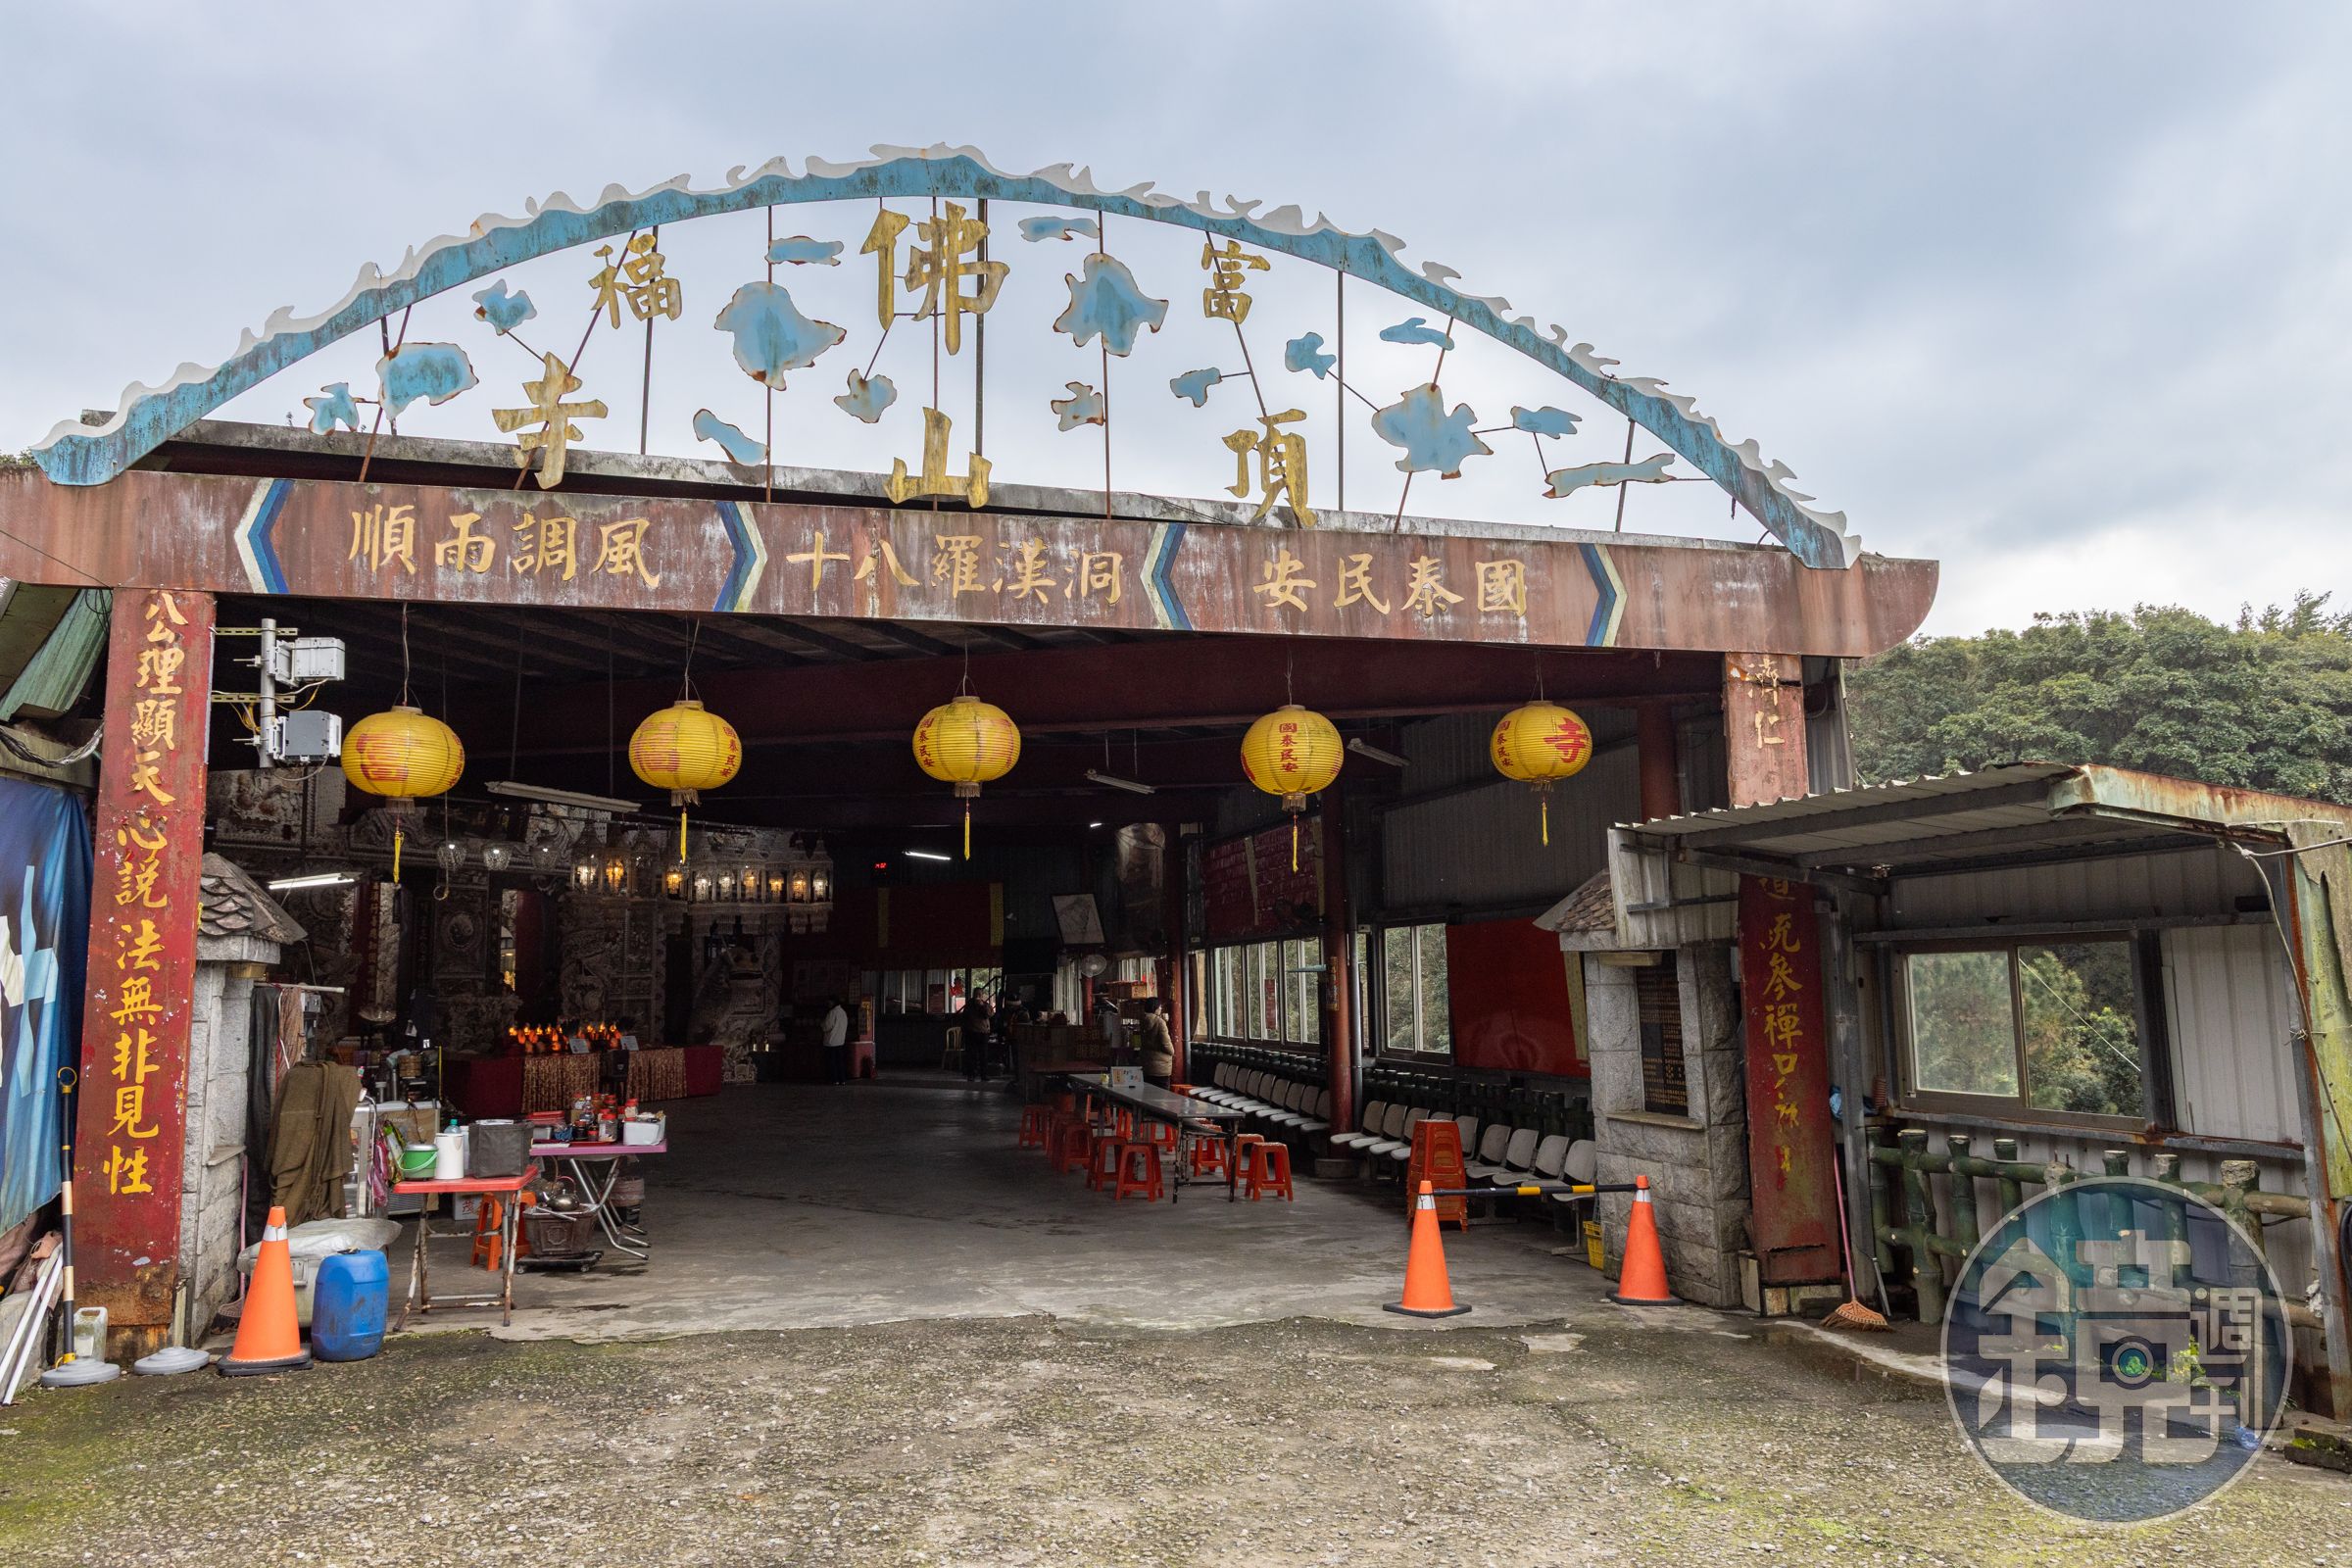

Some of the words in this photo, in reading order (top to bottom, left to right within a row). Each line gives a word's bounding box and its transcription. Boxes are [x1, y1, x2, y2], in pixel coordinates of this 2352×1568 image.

[786, 530, 1124, 608] 十八羅漢洞
[1279, 722, 1298, 773] 國泰民安
[1544, 716, 1590, 764] 寺
